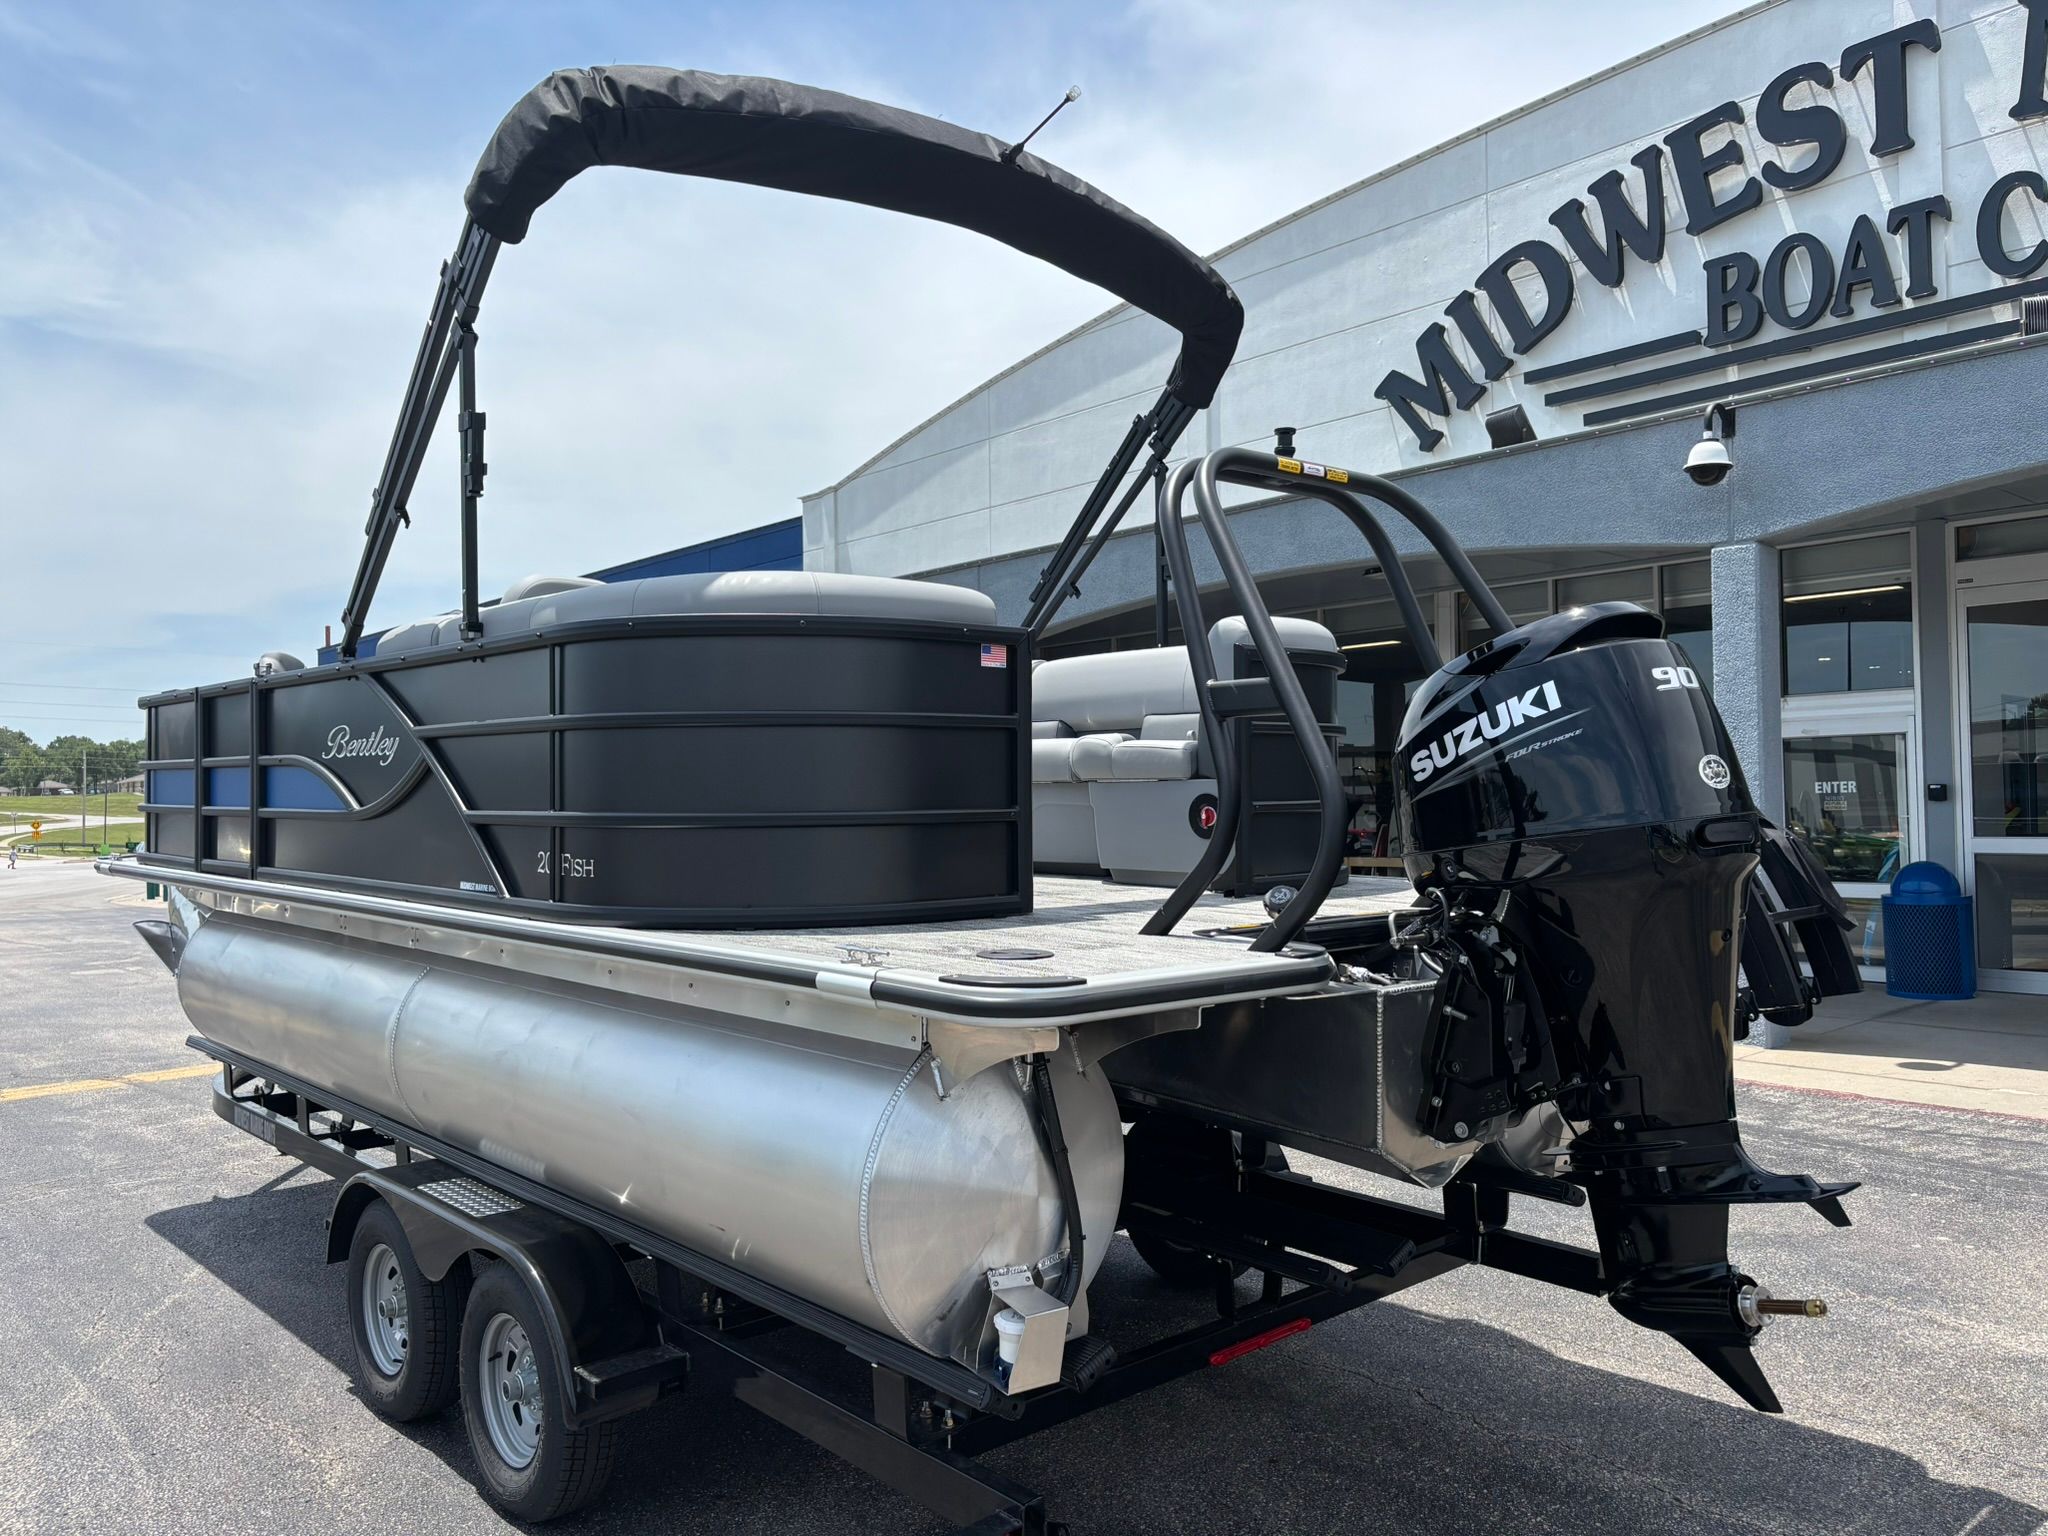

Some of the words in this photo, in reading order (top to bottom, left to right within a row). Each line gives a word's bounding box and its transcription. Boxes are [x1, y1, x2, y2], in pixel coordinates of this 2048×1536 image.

[1373, 18, 1942, 453] MIDWEST
[1702, 194, 1952, 348] BOAT
[1651, 666, 1701, 691] 90
[321, 724, 400, 766] Bentley
[1410, 680, 1562, 783] SUZUKI
[1814, 780, 1857, 794] ENTER
